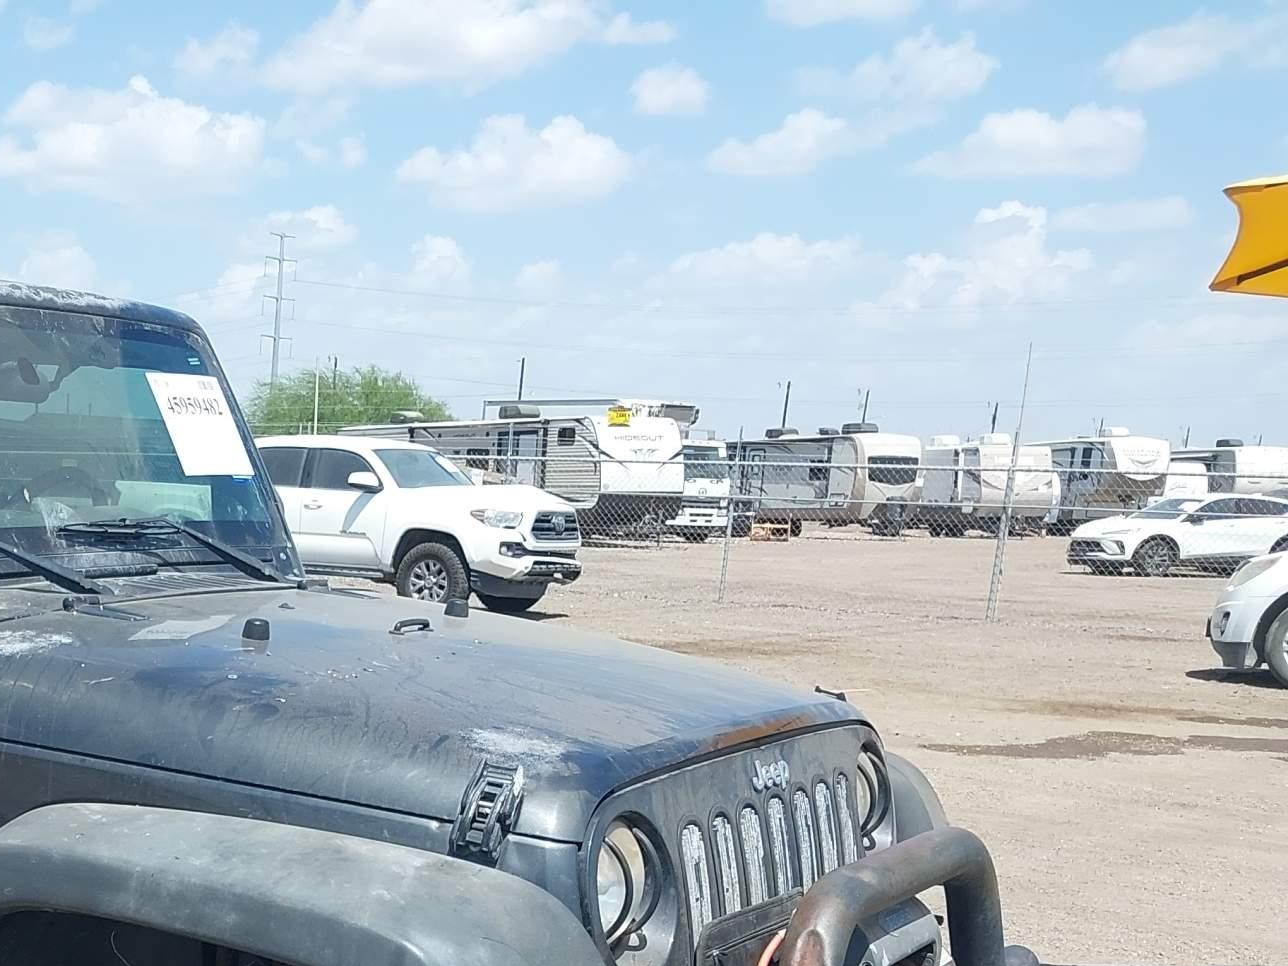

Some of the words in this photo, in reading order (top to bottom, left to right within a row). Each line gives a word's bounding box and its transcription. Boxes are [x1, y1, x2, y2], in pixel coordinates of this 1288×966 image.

[167, 396, 223, 416] 45959482
[614, 434, 664, 442] HIDEOUT
[752, 759, 790, 790] Jeep
